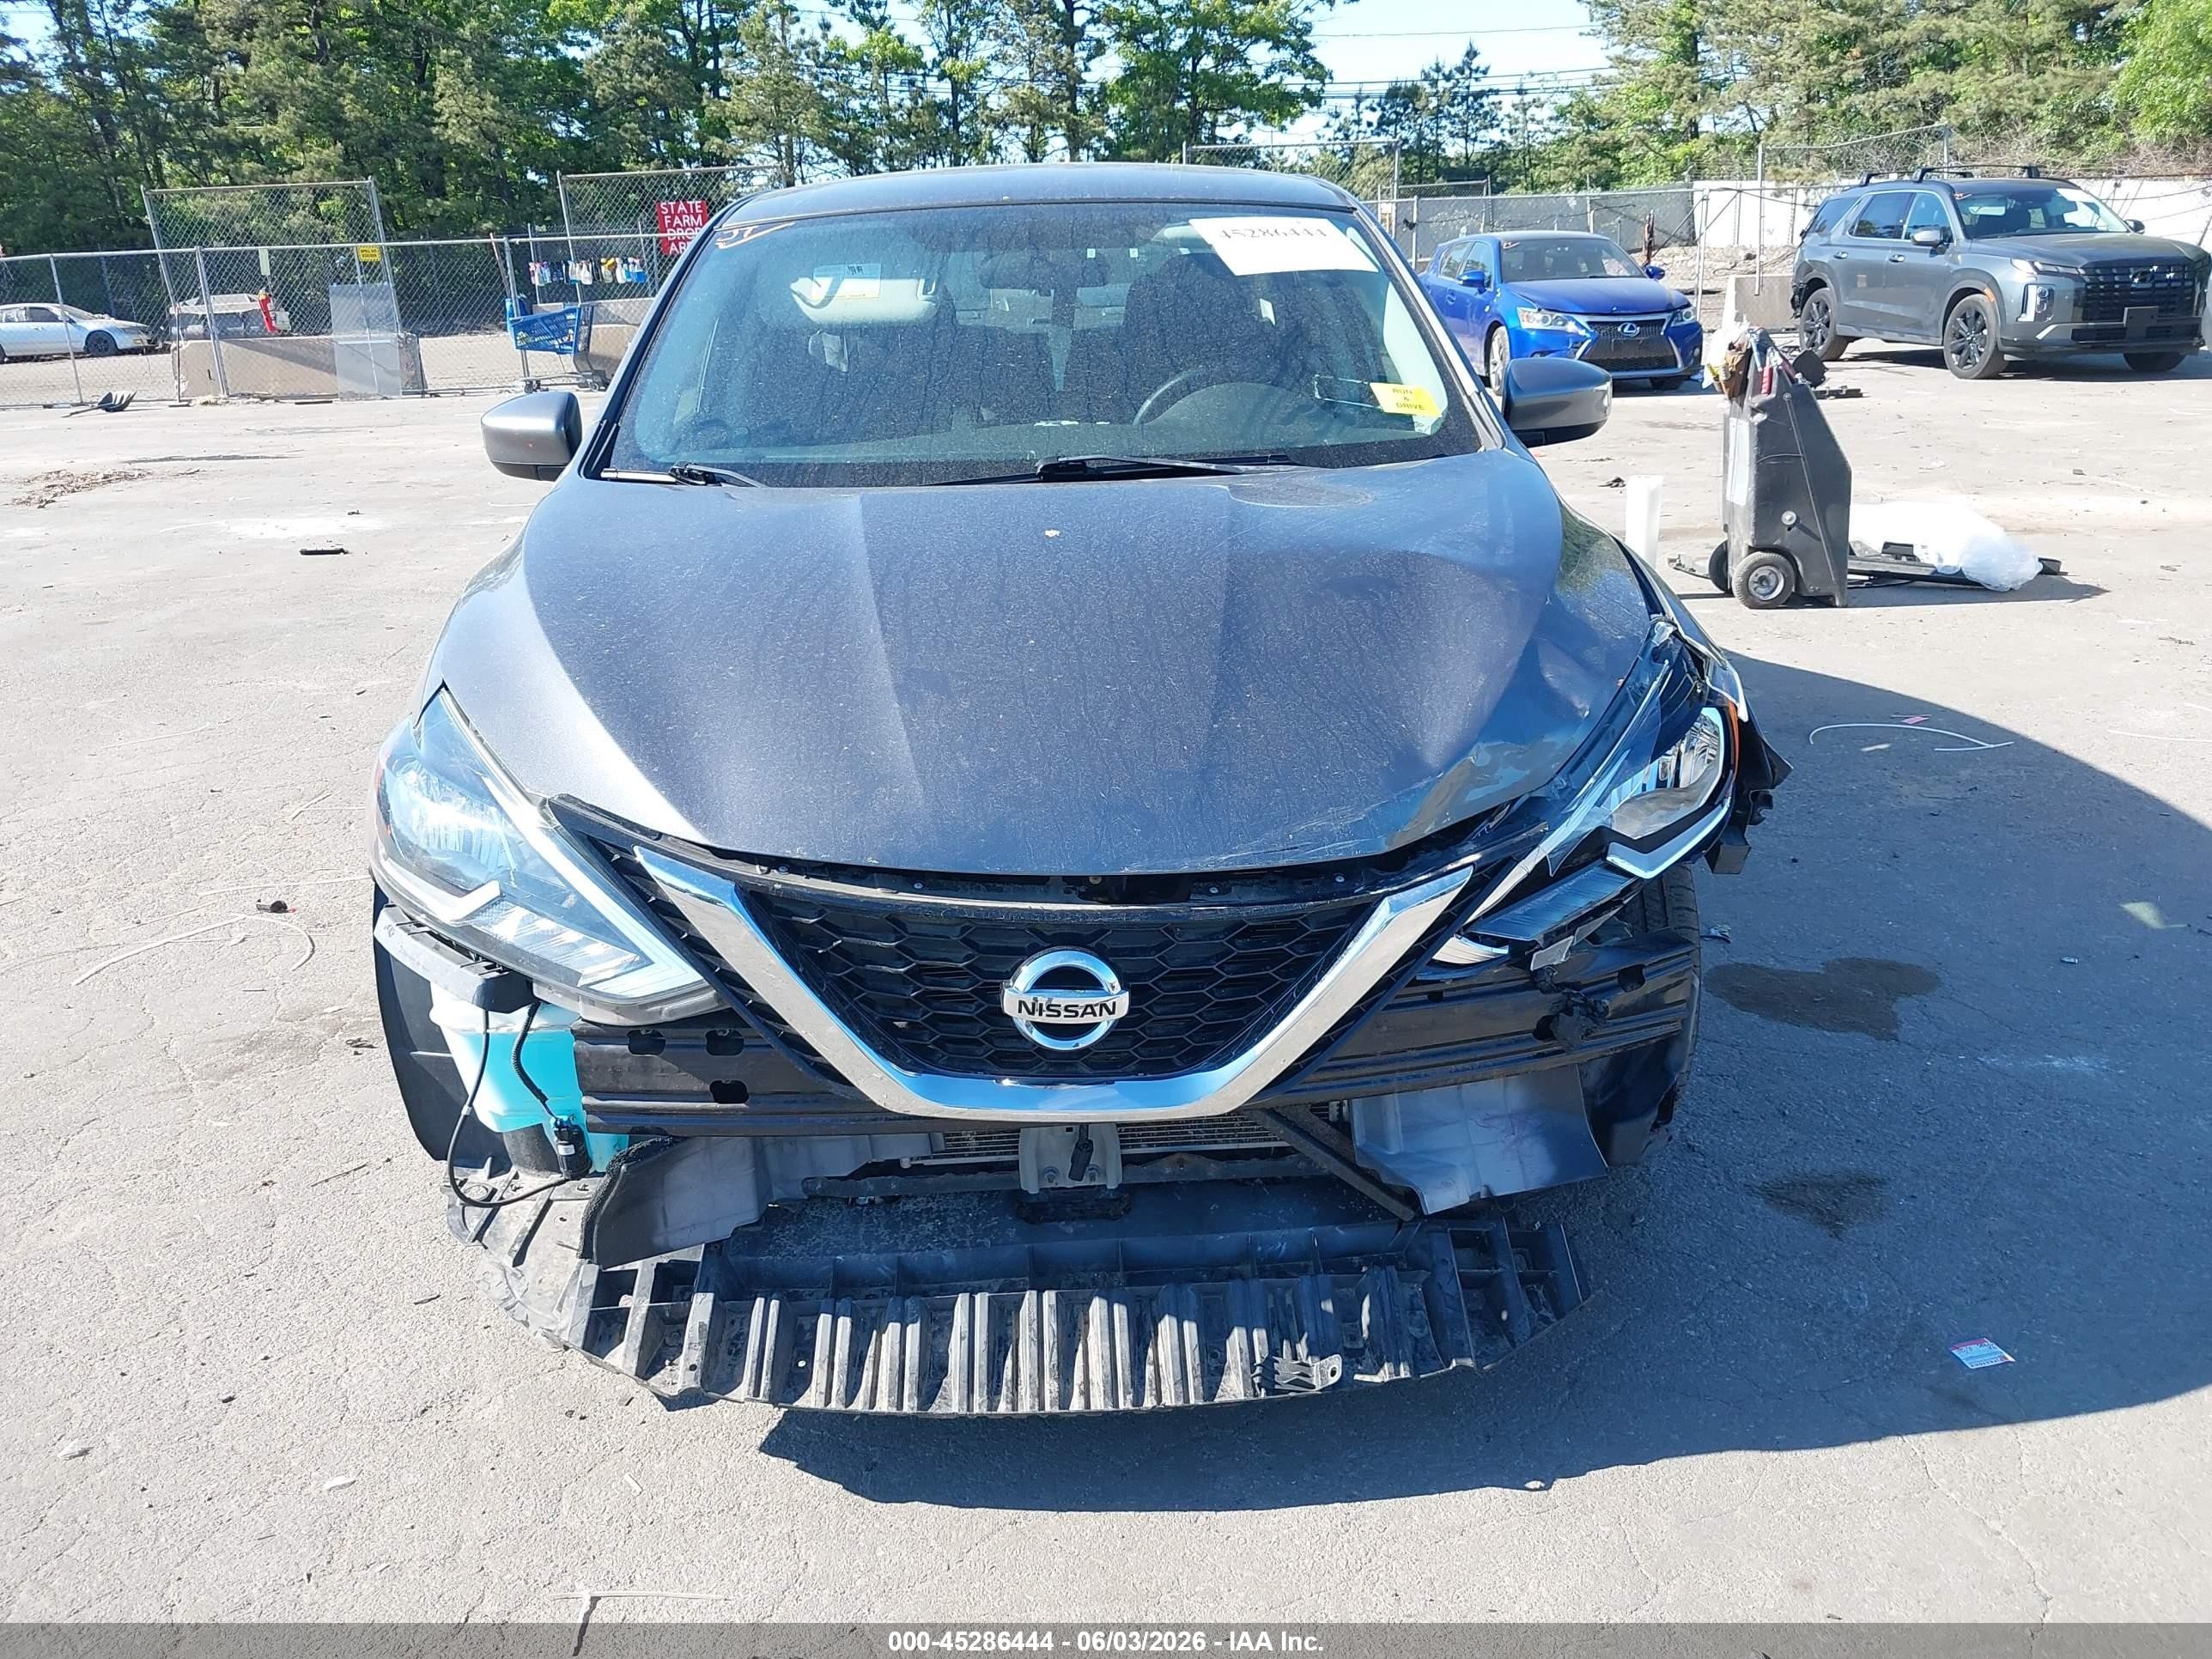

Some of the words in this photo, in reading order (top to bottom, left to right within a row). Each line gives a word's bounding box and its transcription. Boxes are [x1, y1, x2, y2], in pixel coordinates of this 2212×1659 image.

[660, 200, 703, 215] STATE
[664, 214, 703, 228] FARM
[1018, 1000, 1116, 1018] NISSAN
